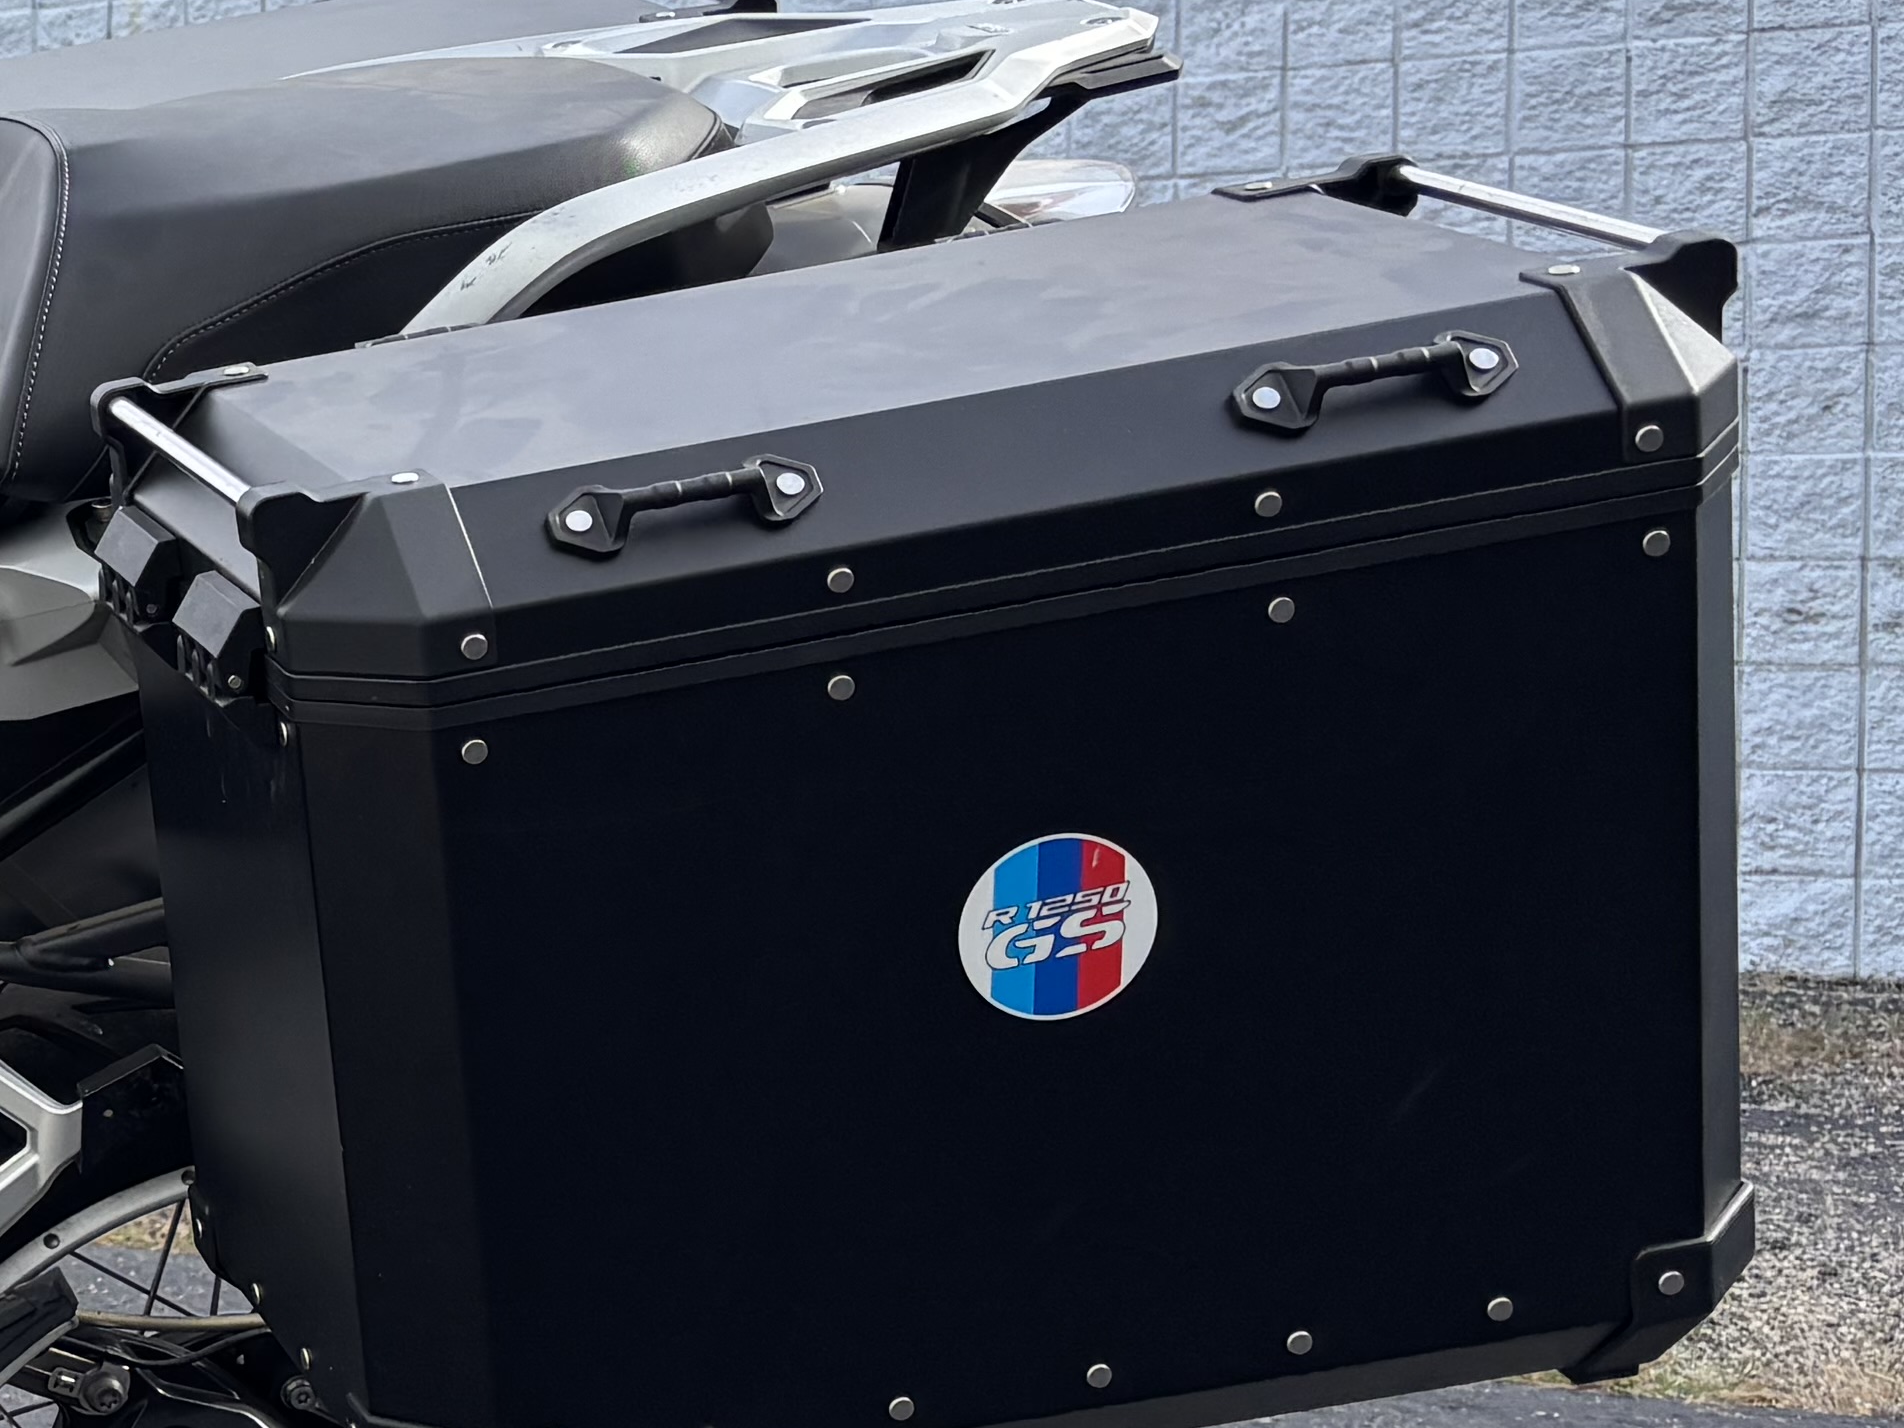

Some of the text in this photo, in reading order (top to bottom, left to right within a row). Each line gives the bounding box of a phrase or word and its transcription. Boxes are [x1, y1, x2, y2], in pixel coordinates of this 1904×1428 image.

[982, 880, 1131, 930] R 1250
[985, 900, 1131, 970] GS
